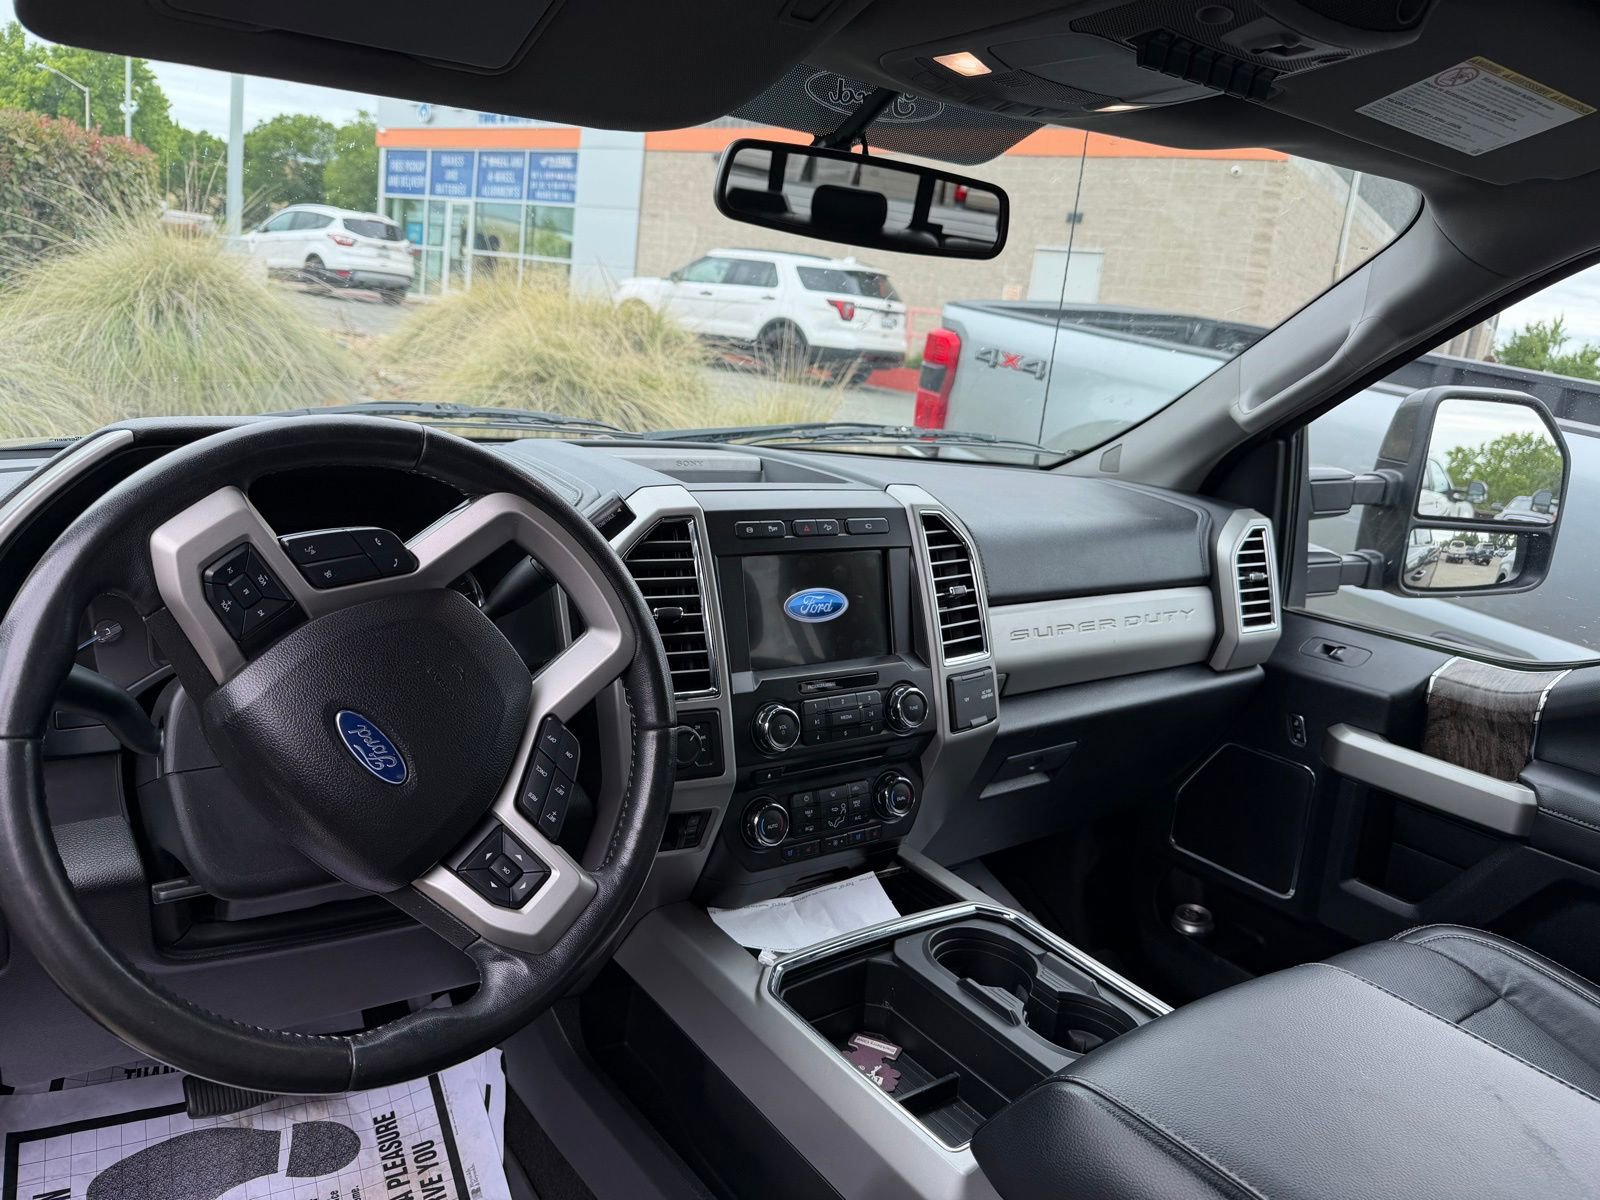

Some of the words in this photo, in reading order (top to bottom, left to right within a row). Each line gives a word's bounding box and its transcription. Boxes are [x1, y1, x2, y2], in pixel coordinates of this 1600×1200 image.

[675, 459, 704, 467] SONY
[799, 594, 834, 615] Ford
[1009, 618, 1118, 642] SUPER
[1124, 607, 1195, 628] DUTY
[347, 723, 398, 771] Ford
[502, 866, 511, 875] OK
[372, 1110, 411, 1190] PLEASURE
[411, 1139, 440, 1176] YOU
